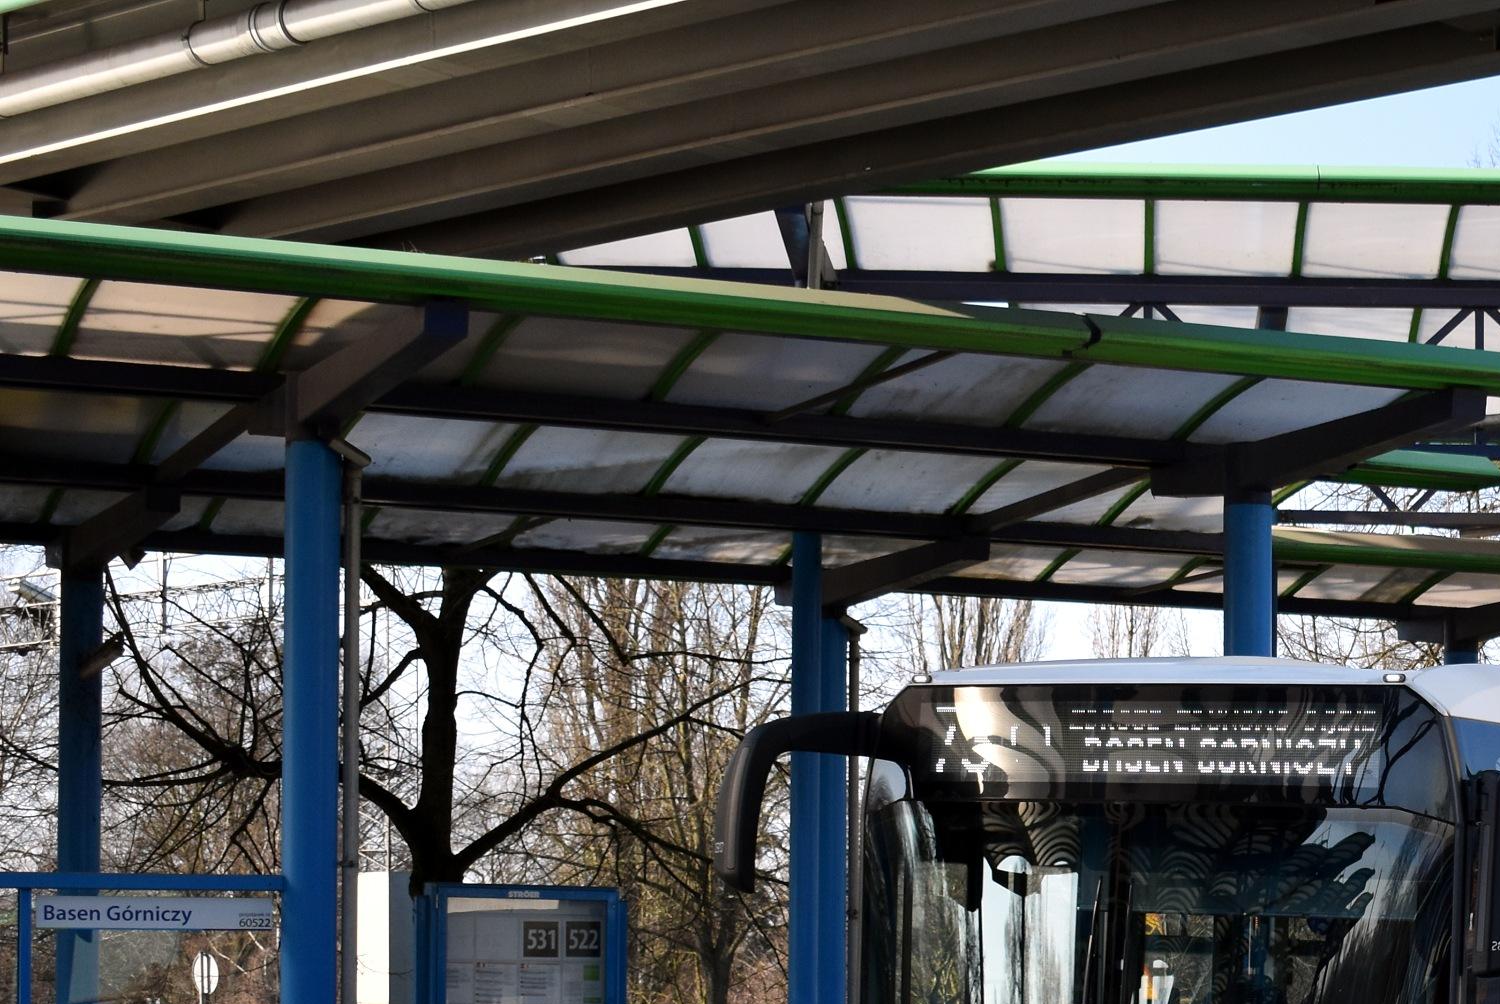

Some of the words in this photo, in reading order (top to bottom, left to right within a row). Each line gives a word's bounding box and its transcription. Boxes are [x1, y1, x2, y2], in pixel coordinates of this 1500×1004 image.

[43, 904, 101, 921] Basen
[106, 905, 192, 926] Górniczy
[239, 918, 271, 928] 60522
[527, 928, 557, 950] 531
[568, 928, 599, 950] 522
